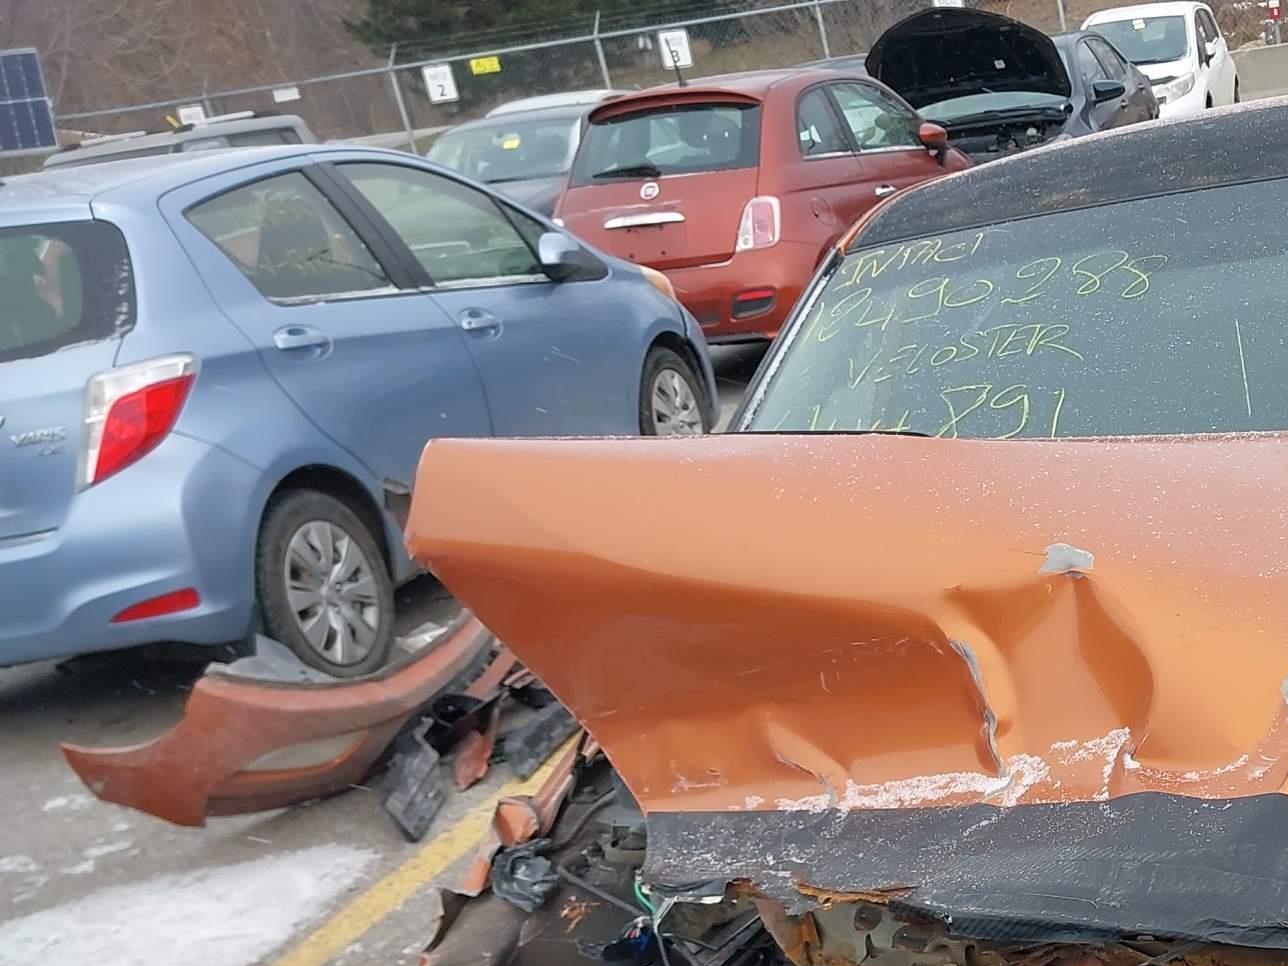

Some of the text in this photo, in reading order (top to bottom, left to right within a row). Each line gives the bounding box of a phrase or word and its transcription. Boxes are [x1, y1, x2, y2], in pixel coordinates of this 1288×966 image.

[437, 84, 447, 97] 2
[832, 230, 1010, 290] INTACT
[800, 250, 1169, 346] 12490288
[848, 323, 1085, 389] VELOSTER
